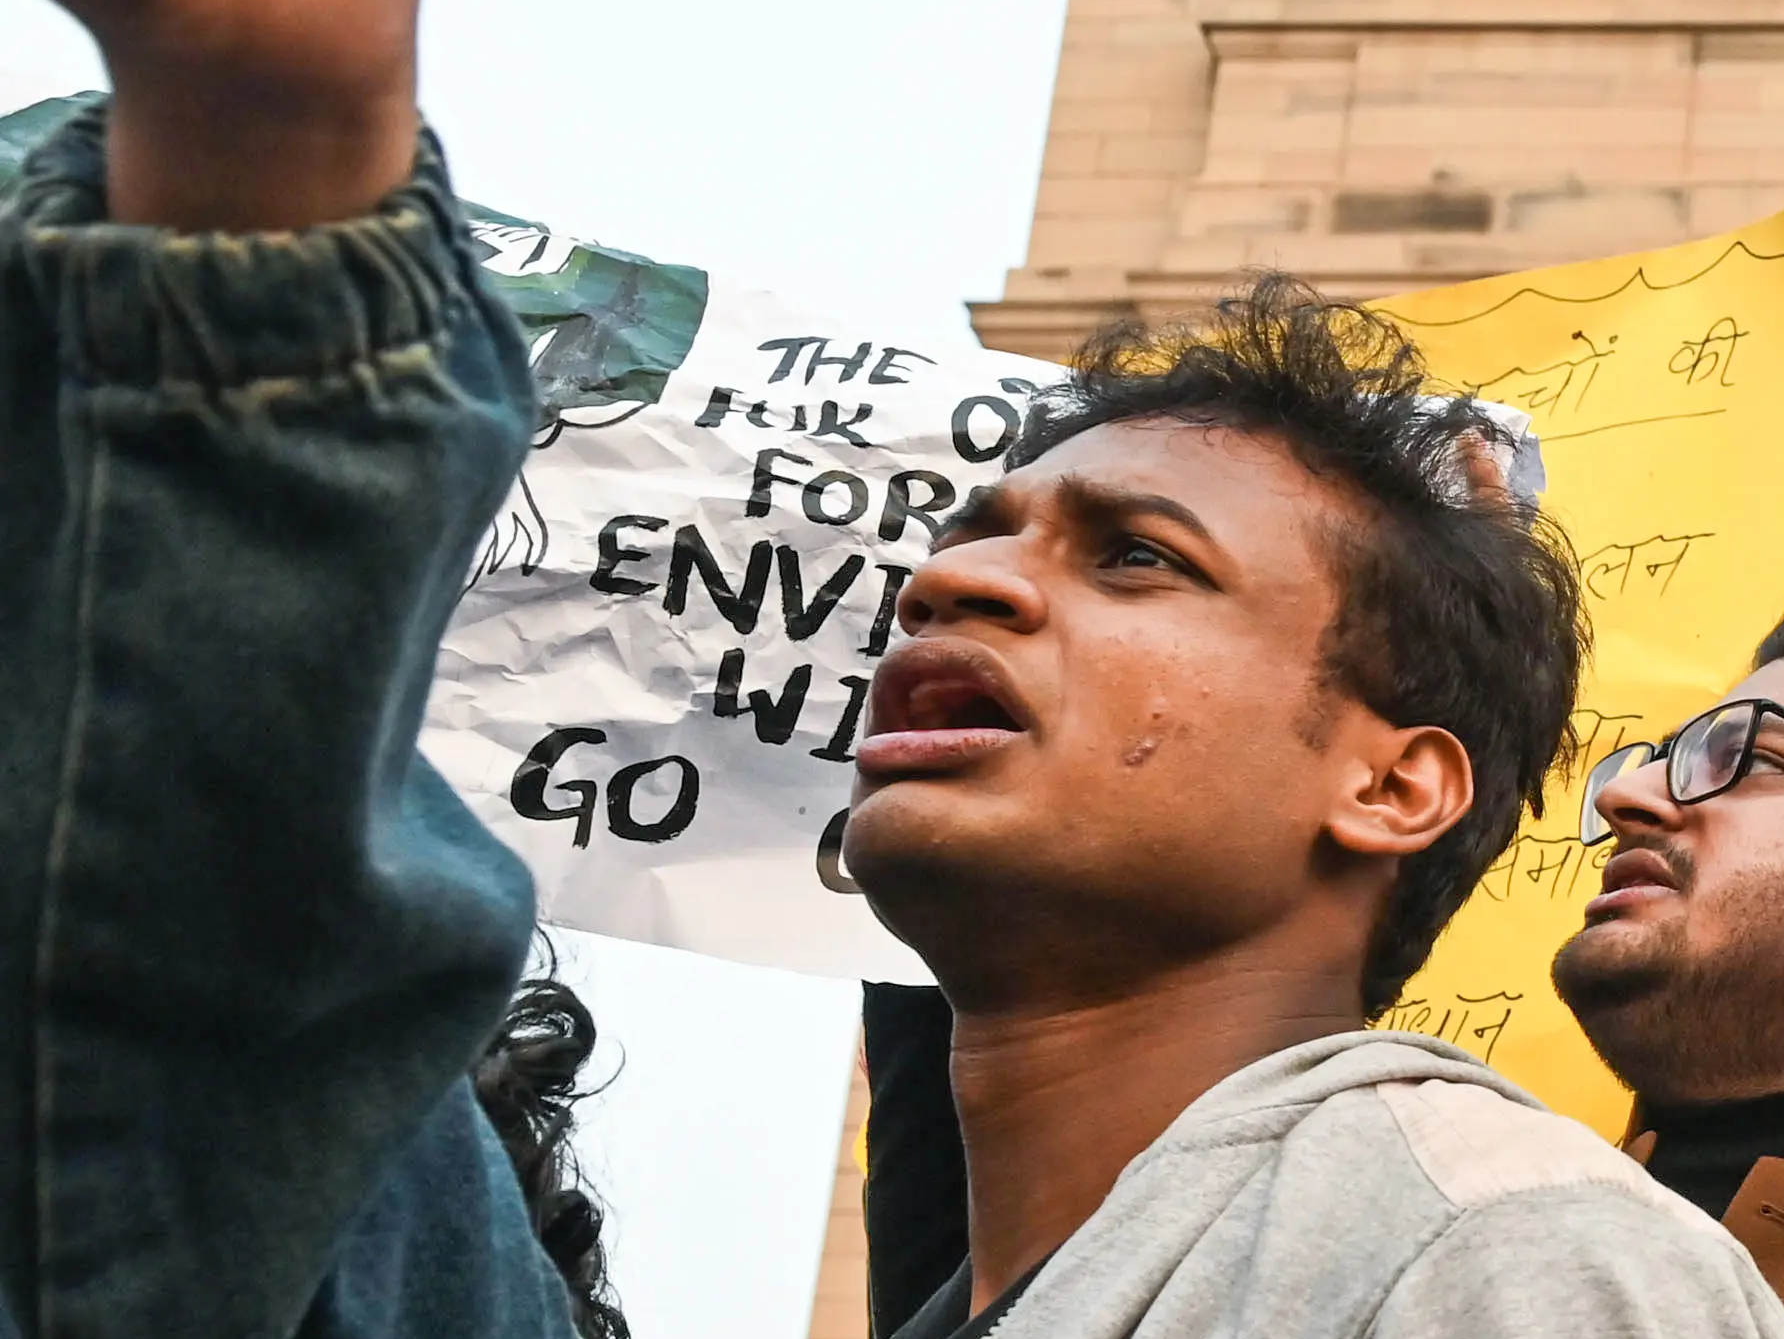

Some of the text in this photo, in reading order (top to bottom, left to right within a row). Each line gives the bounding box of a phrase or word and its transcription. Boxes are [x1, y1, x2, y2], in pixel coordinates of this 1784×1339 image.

[756, 336, 938, 386] THE
[1668, 317, 1750, 387] की
[744, 448, 957, 542] FOR
[589, 516, 914, 658] ENVI
[510, 728, 700, 849] GO
